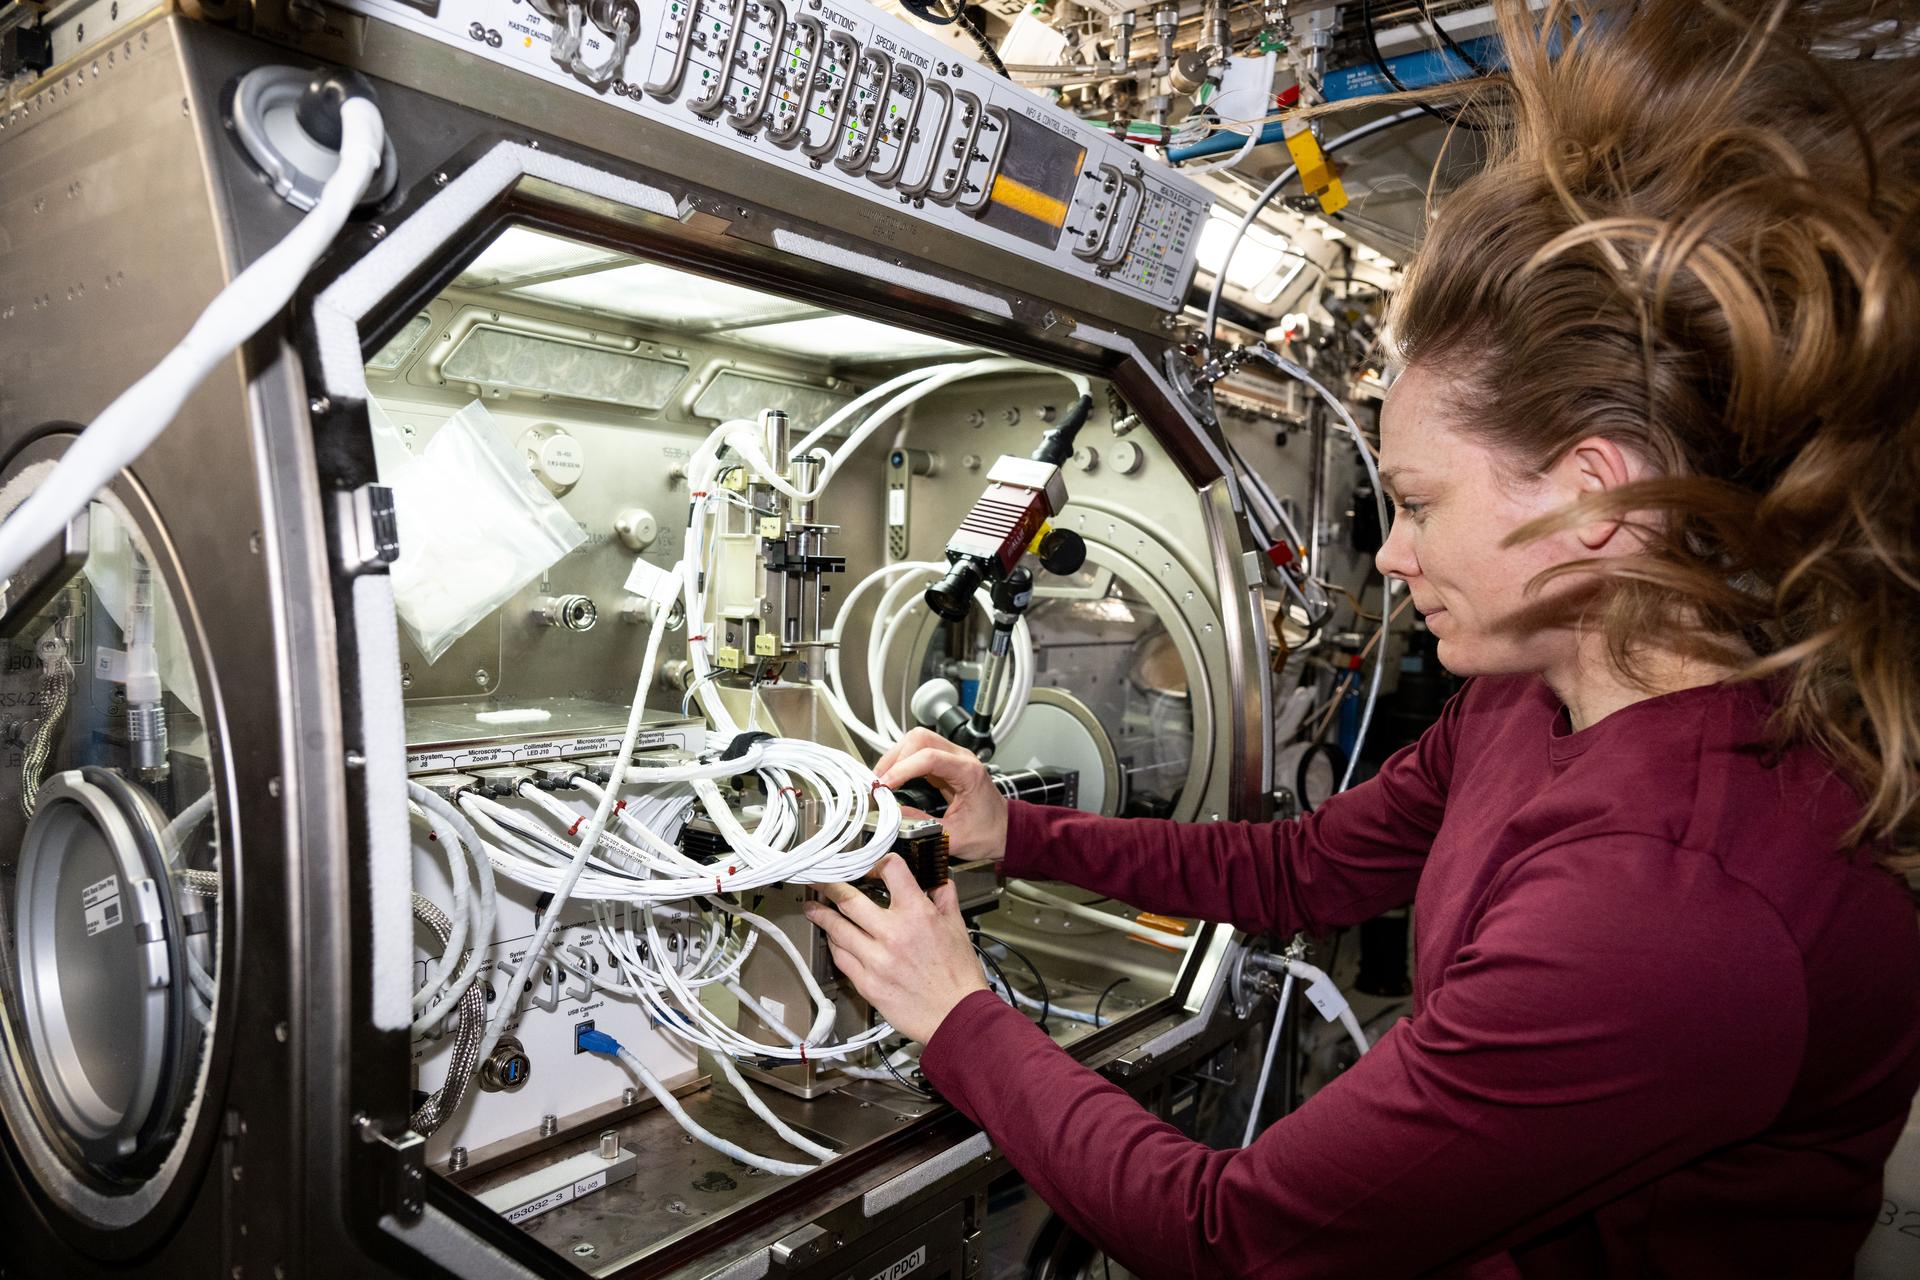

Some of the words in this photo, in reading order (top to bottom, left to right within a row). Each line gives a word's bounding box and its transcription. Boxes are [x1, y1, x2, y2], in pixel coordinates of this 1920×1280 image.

[821, 6, 857, 32] FUNCTIONS
[507, 20, 532, 36] MASTER
[759, 22, 767, 31] OFF
[664, 31, 674, 40] OFF
[707, 50, 716, 59] OFF
[874, 34, 898, 55] SPECIAL
[898, 47, 930, 70] FUNCTIONS
[747, 68, 755, 76] OFF
[1025, 106, 1037, 119] INFO
[1041, 115, 1061, 132] CONTROL
[638, 731, 665, 739] Dispensing
[576, 737, 606, 745] Microscope
[638, 738, 656, 746] System
[523, 742, 553, 751] Collimated
[574, 743, 599, 752] Assembly
[598, 742, 608, 750] J11
[468, 747, 502, 756] Microscope
[539, 748, 550, 756] J10
[420, 753, 444, 763] System
[472, 755, 490, 763] Zoom
[490, 754, 498, 762] J9
[420, 760, 428, 768] J8
[560, 921, 587, 931] Secondary
[580, 934, 593, 942] Spin
[567, 1007, 580, 1016] USB
[889, 1251, 921, 1280] (PDC)
